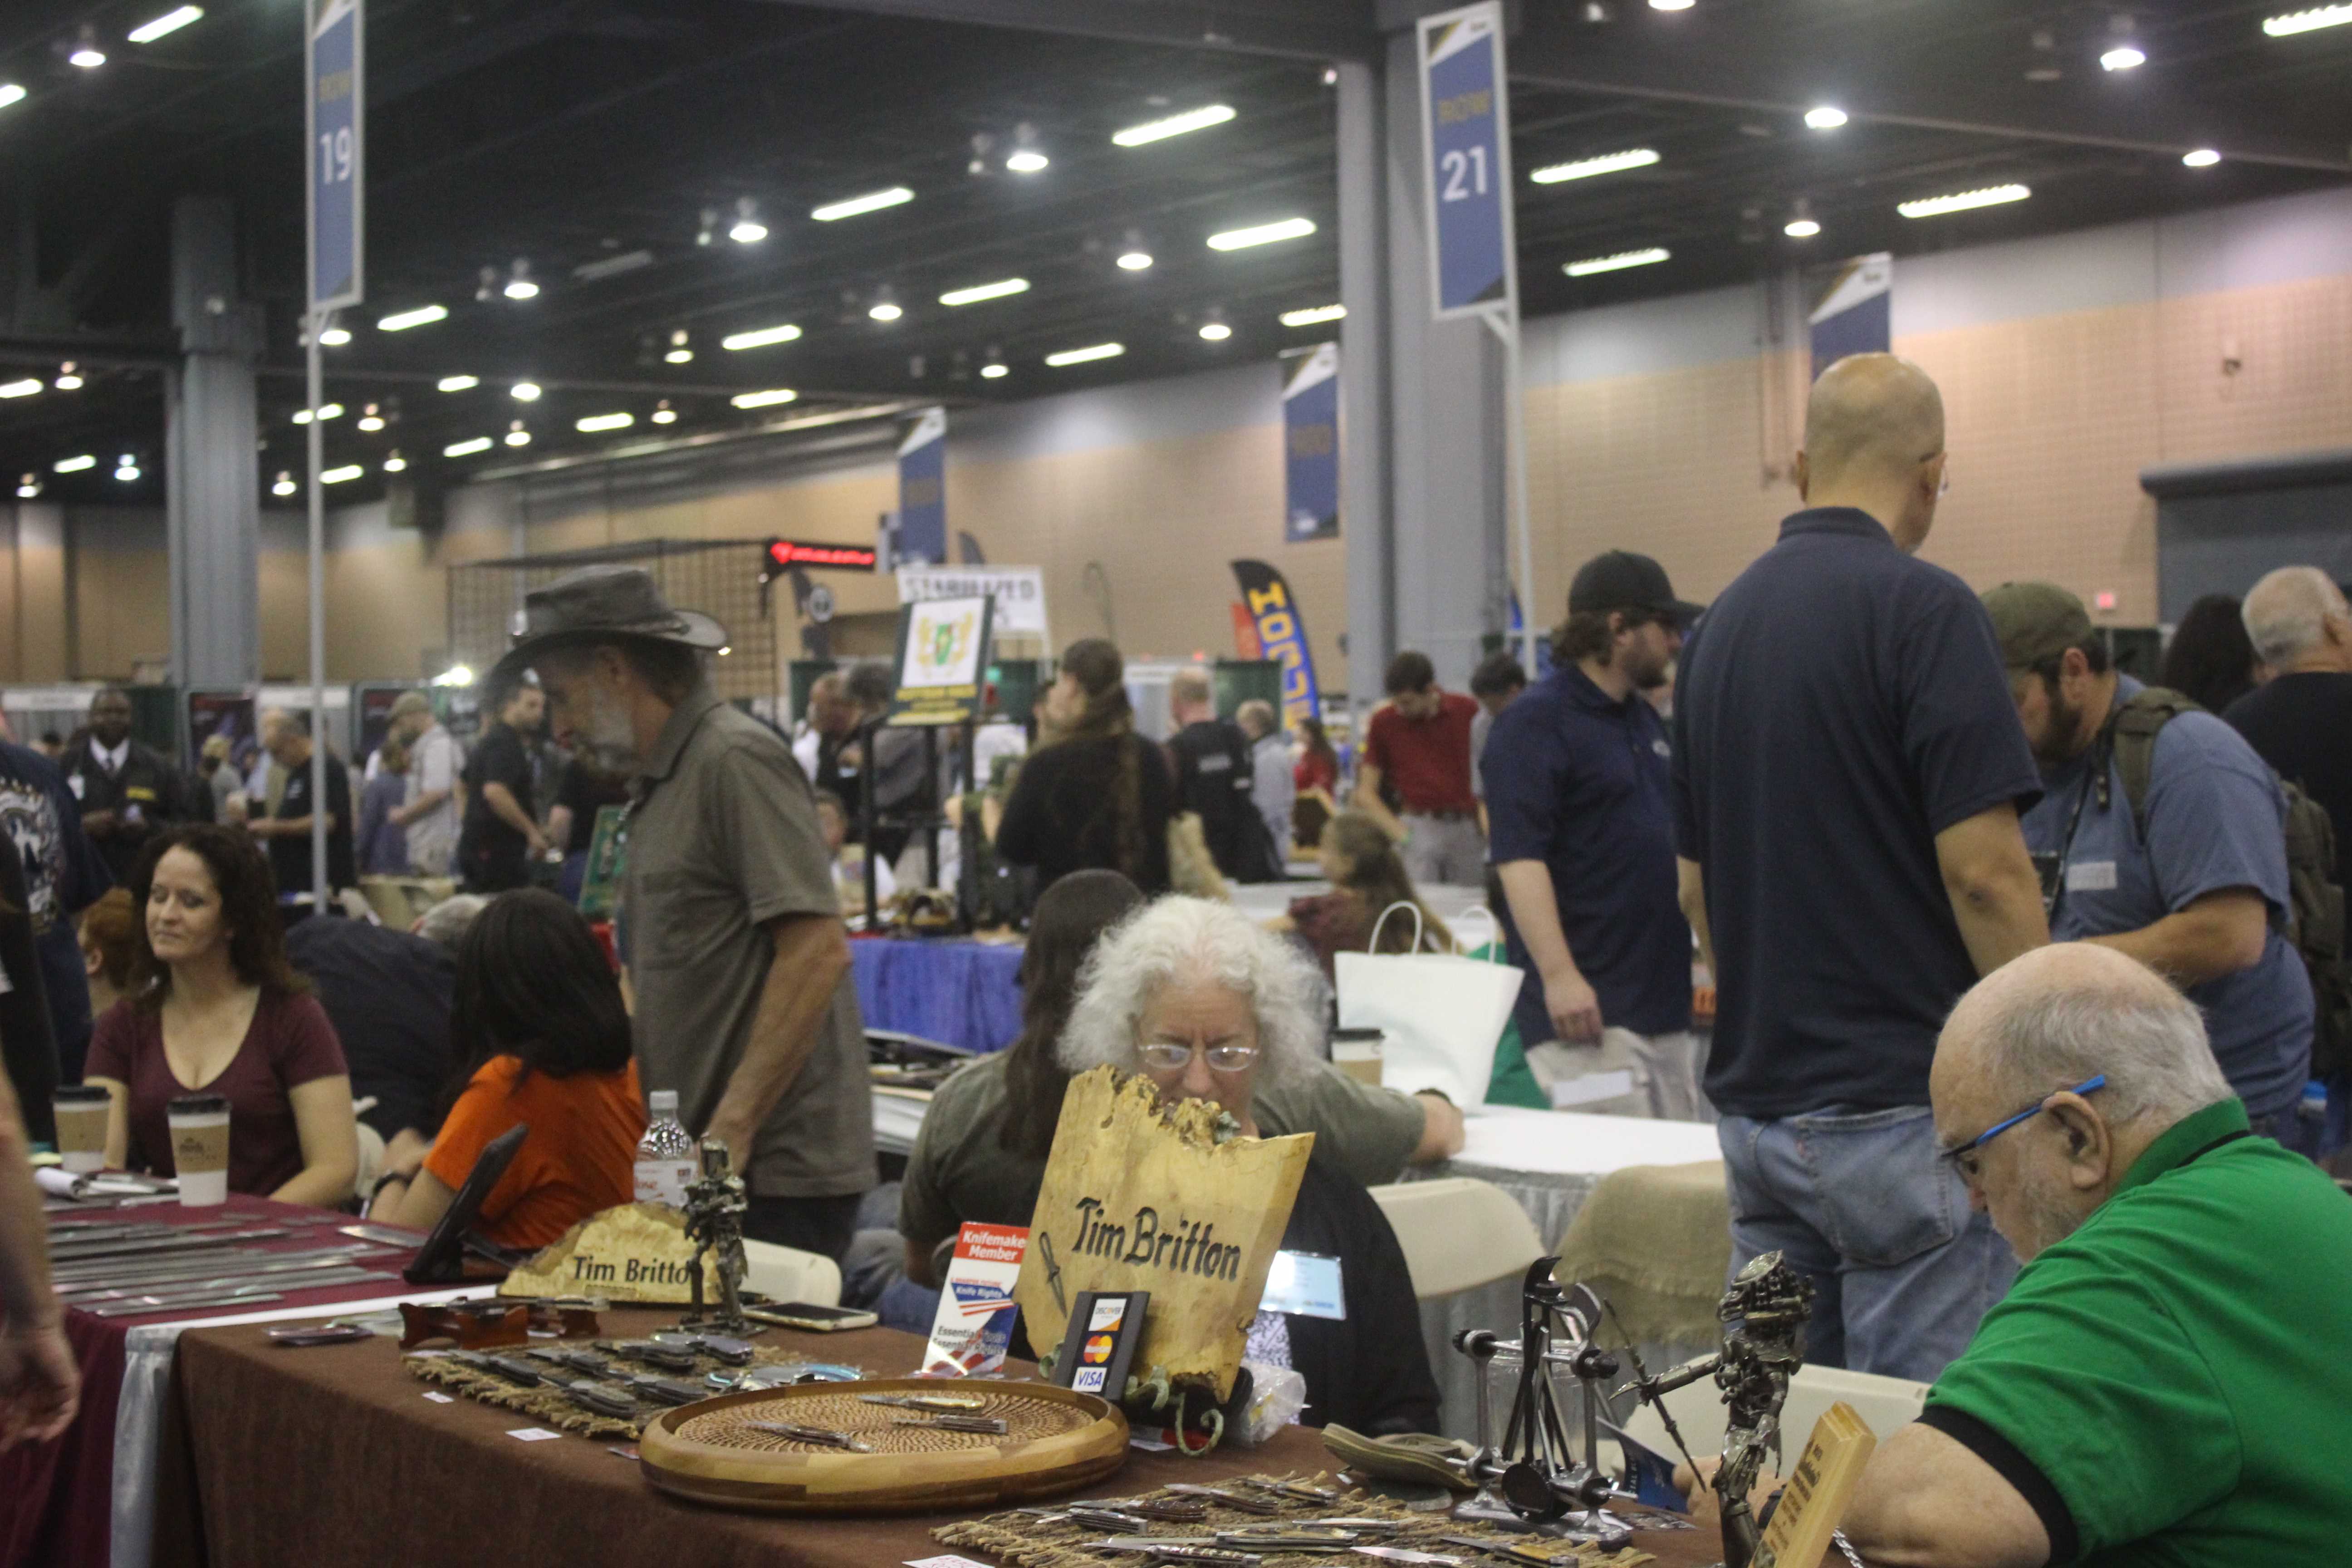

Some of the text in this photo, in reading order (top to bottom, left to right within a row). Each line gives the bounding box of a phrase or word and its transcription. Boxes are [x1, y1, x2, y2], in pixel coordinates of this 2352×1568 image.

[320, 126, 352, 182] 19
[1441, 145, 1487, 201] 21
[962, 1230, 1027, 1248] Knifemake
[1072, 1196, 1126, 1261] Tim
[1122, 1207, 1240, 1282] Britton
[968, 1245, 1018, 1260] Member
[574, 1255, 692, 1284] Tim Britto
[956, 1287, 1004, 1299] Knife Rights
[1078, 1371, 1103, 1386] VISA
